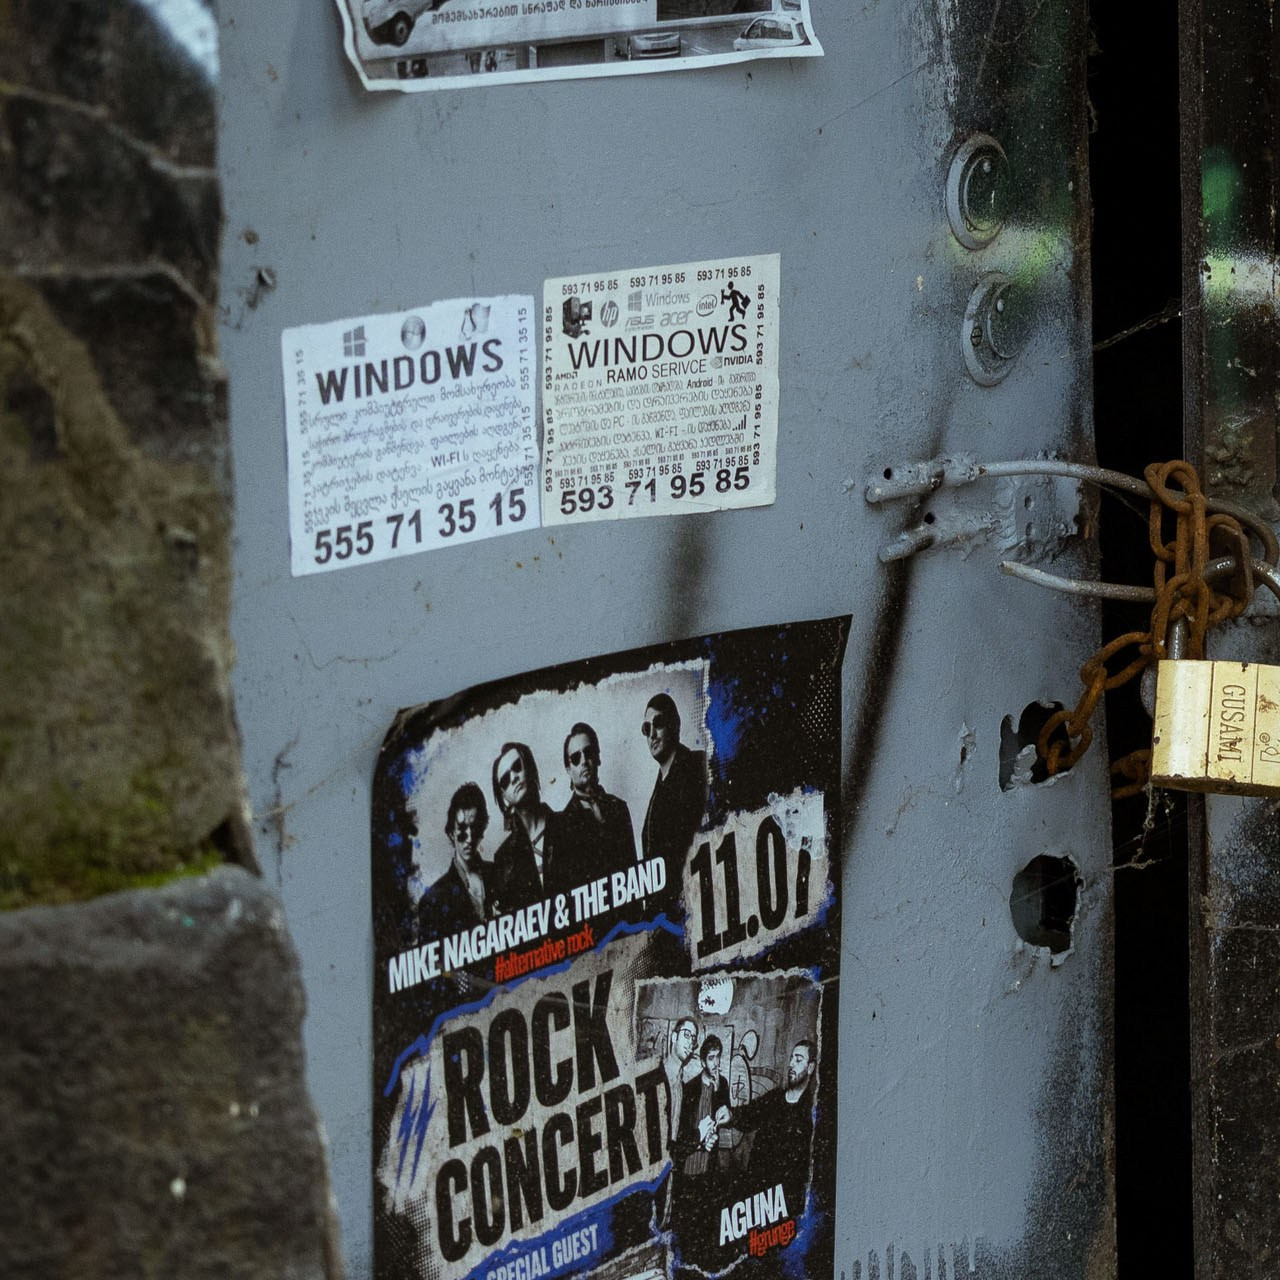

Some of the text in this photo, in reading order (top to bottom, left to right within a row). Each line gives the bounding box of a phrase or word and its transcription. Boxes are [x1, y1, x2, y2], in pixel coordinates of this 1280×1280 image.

[562, 266, 752, 296] 593 71 95 85 593 71 95 85 593 71 95 85
[645, 291, 690, 307] Windows
[660, 309, 694, 327] acer
[568, 323, 748, 370] WINDOWS
[316, 338, 504, 406] WINDOWS
[607, 364, 648, 384] RAMO
[687, 376, 714, 389] Android
[431, 452, 461, 469] WI-FI
[560, 466, 751, 515] 593 71 95 85
[315, 487, 528, 565] 555 71 35 15
[389, 856, 667, 994] MIKE NAGARAEV & THE BAND
[495, 922, 595, 983] #alternative rock
[442, 970, 621, 1149] ROCK
[435, 1067, 671, 1263] CONCERT
[719, 1183, 789, 1247] AGUNA
[749, 1219, 795, 1257] #grunge
[552, 1223, 600, 1270] GUEST
